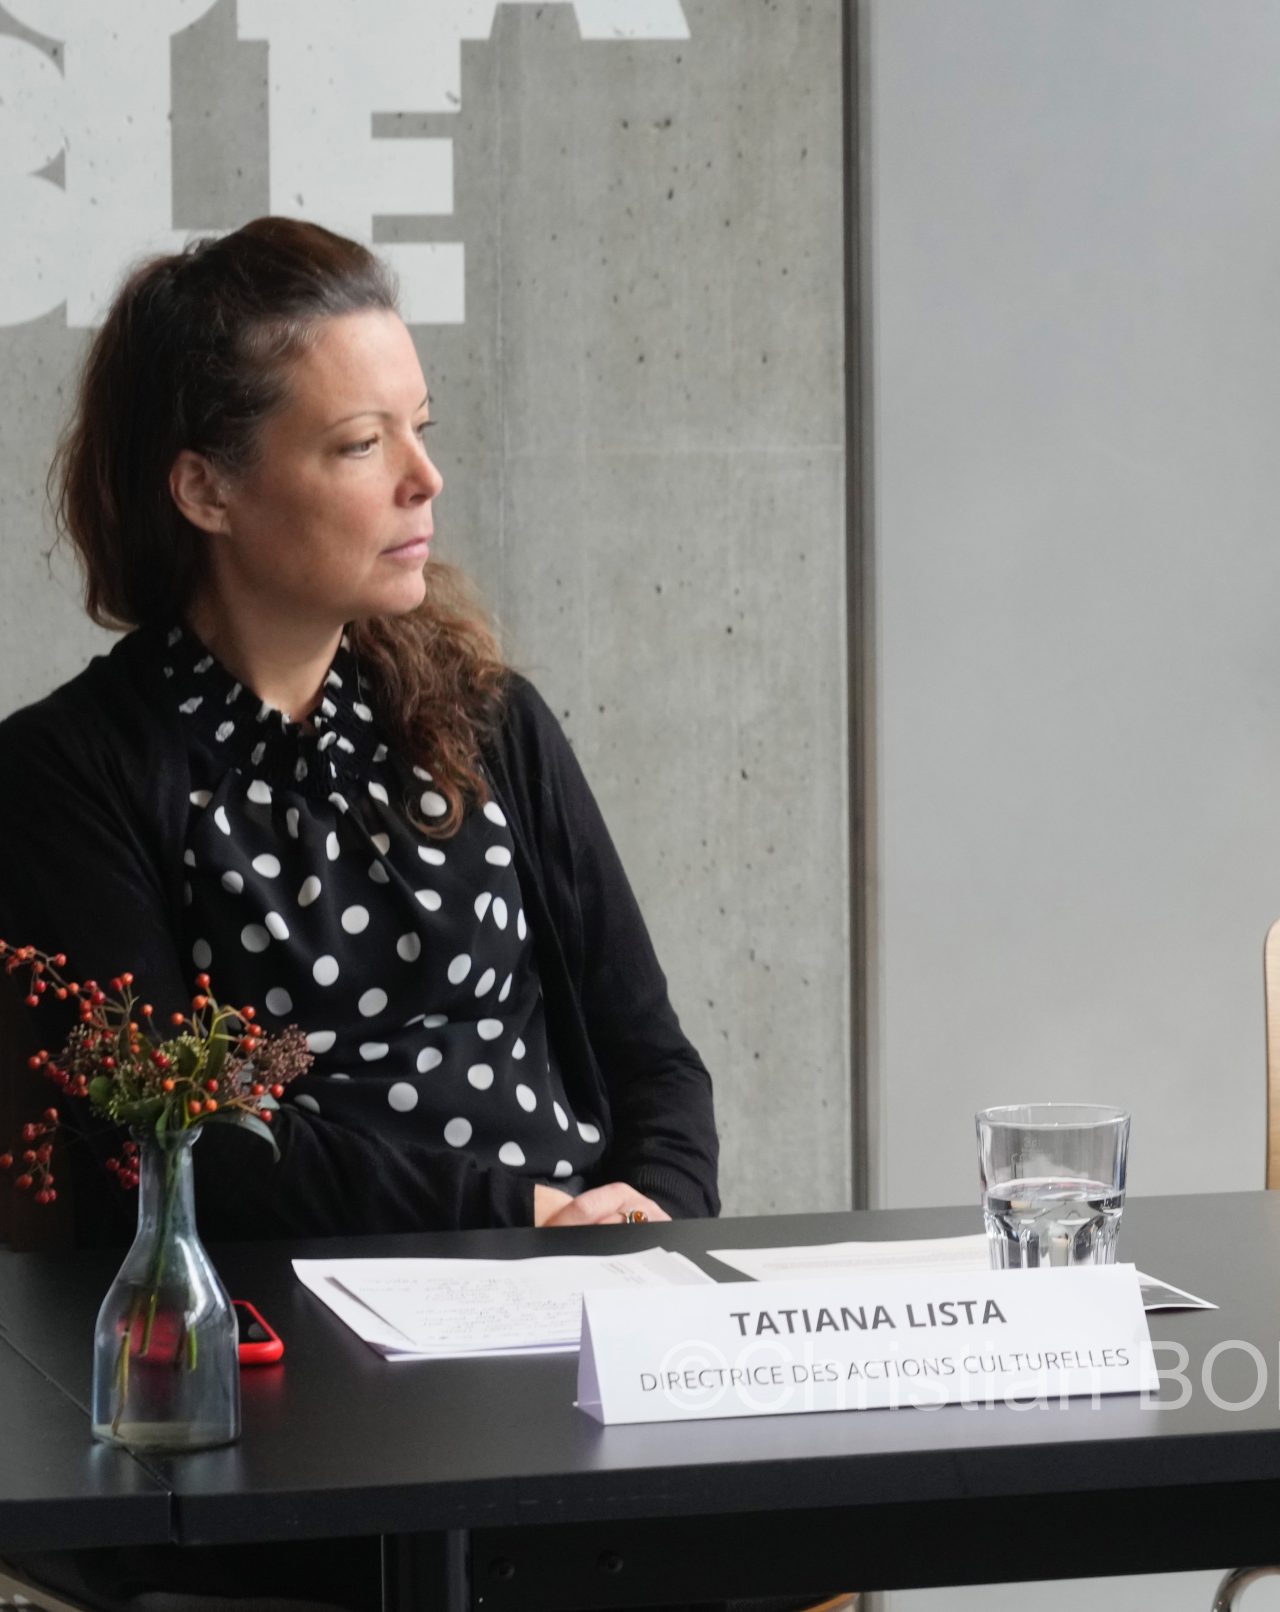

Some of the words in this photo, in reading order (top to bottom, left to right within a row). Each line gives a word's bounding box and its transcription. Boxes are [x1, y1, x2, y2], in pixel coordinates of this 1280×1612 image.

[729, 1301, 897, 1337] TATIANA
[905, 1299, 1008, 1328] LISTA
[639, 1365, 784, 1392] DIRECTRICE
[792, 1362, 839, 1384] DES
[847, 1355, 956, 1381] ACTIONS
[962, 1347, 1131, 1375] CULTURELLES
